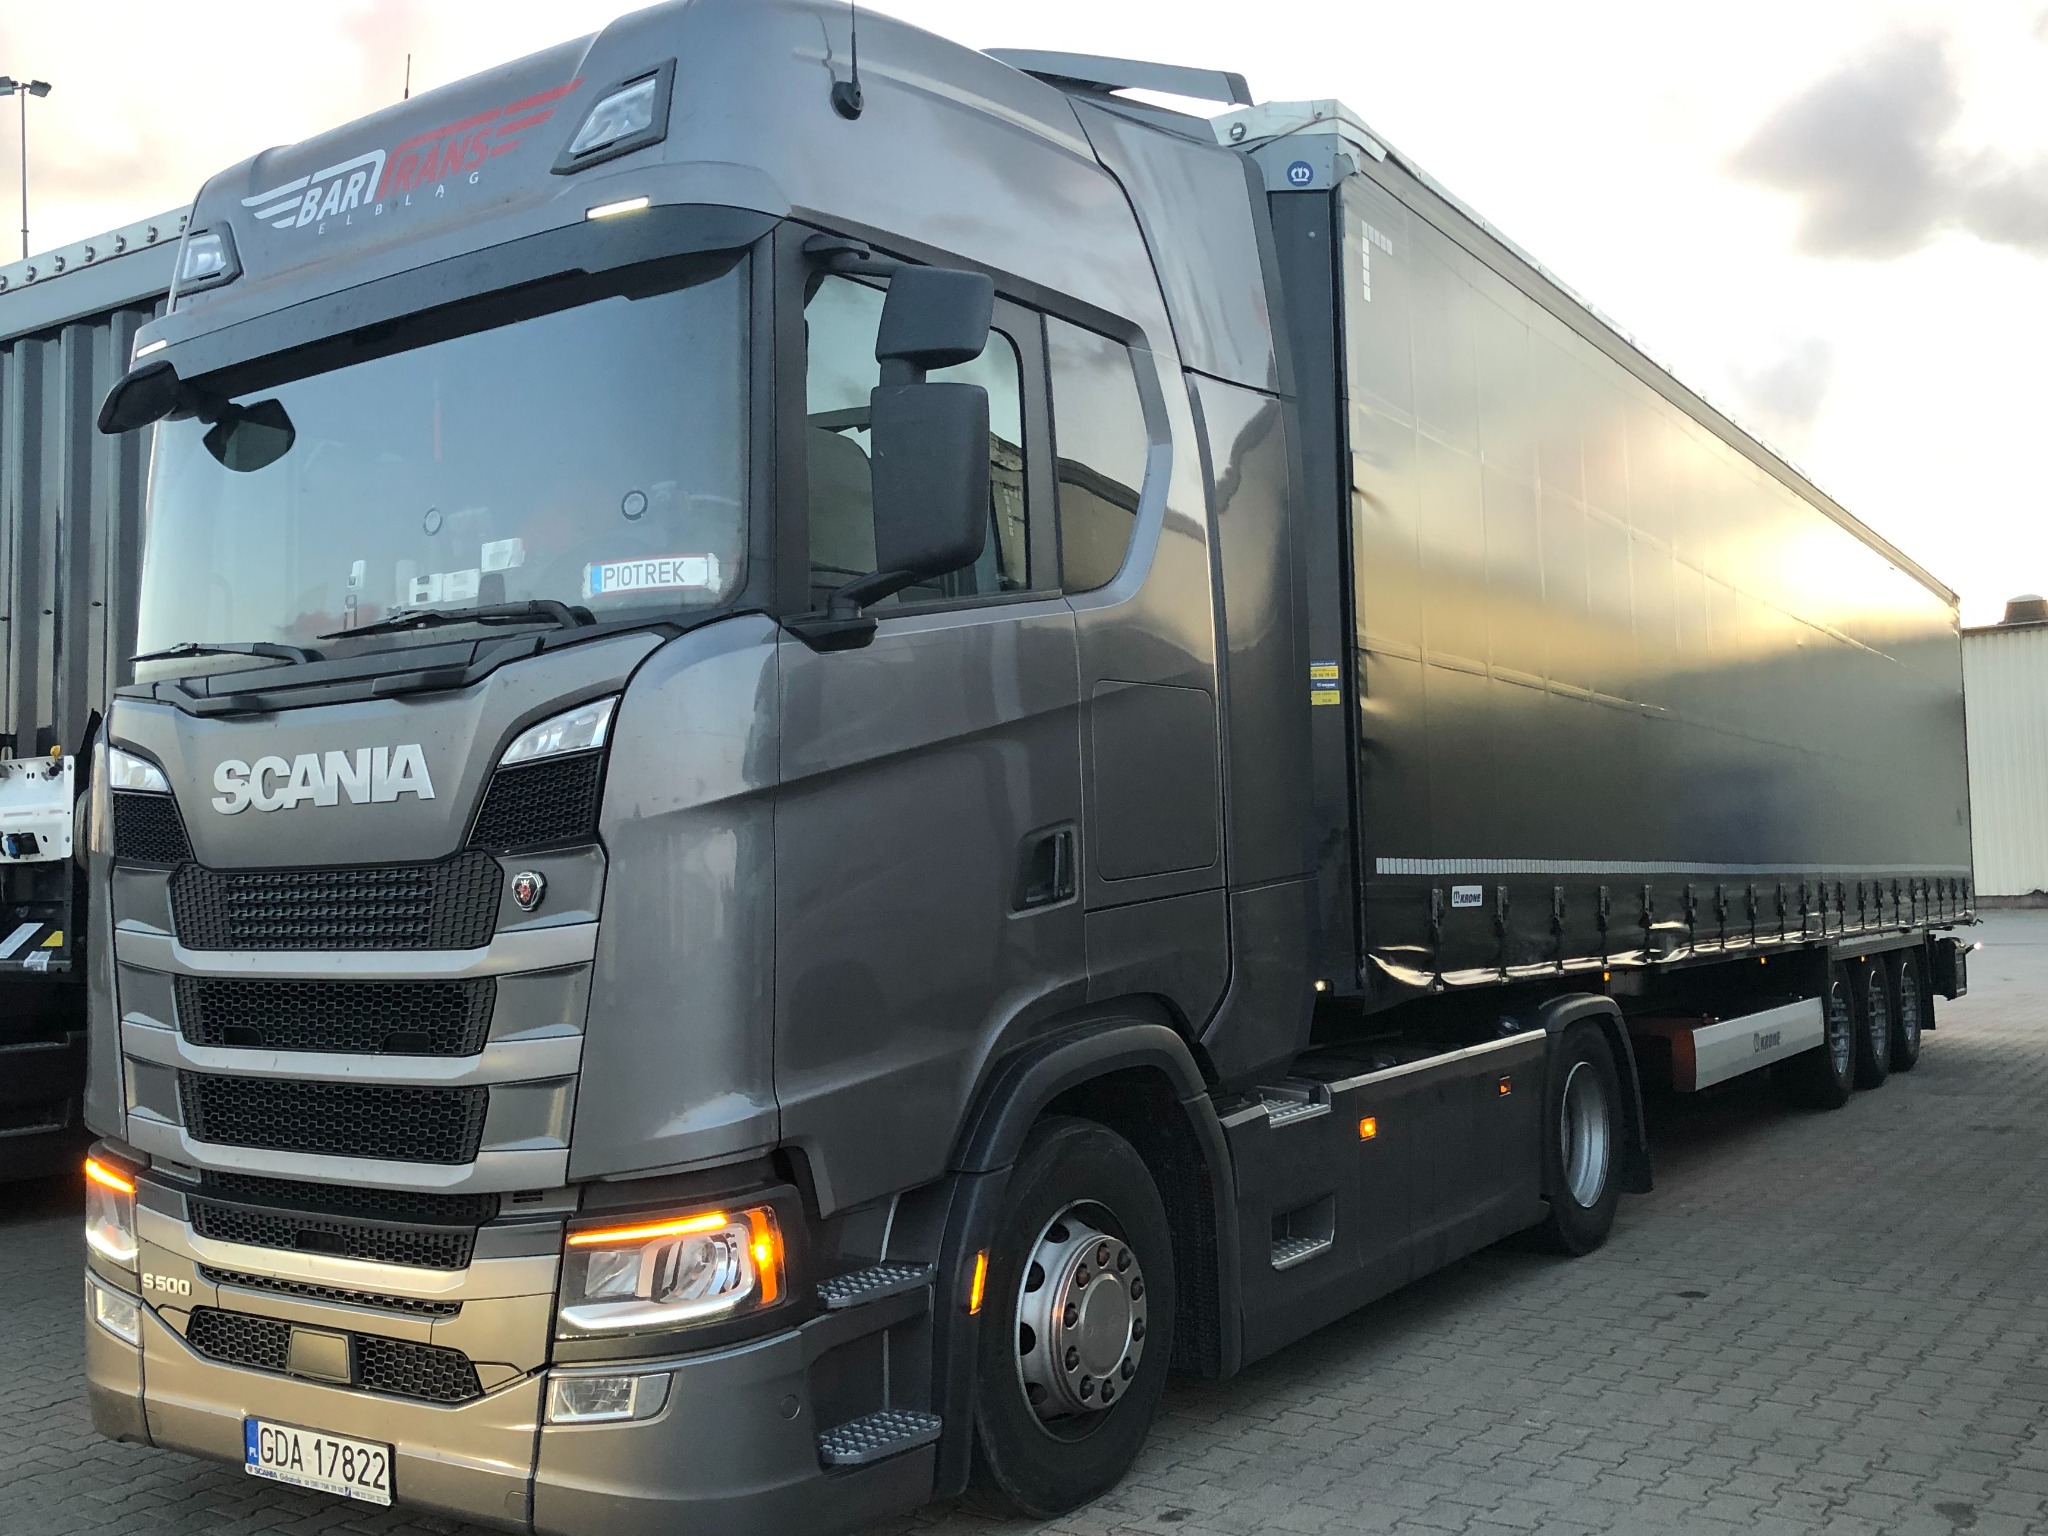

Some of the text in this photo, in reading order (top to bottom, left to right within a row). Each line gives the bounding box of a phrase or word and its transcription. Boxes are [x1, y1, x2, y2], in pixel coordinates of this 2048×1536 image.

[603, 560, 685, 589] PIOTREK
[212, 743, 436, 815] SCANIA
[1460, 893, 1481, 903] KRONE
[248, 1446, 258, 1458] PL
[260, 1427, 386, 1491] GDA 17822
